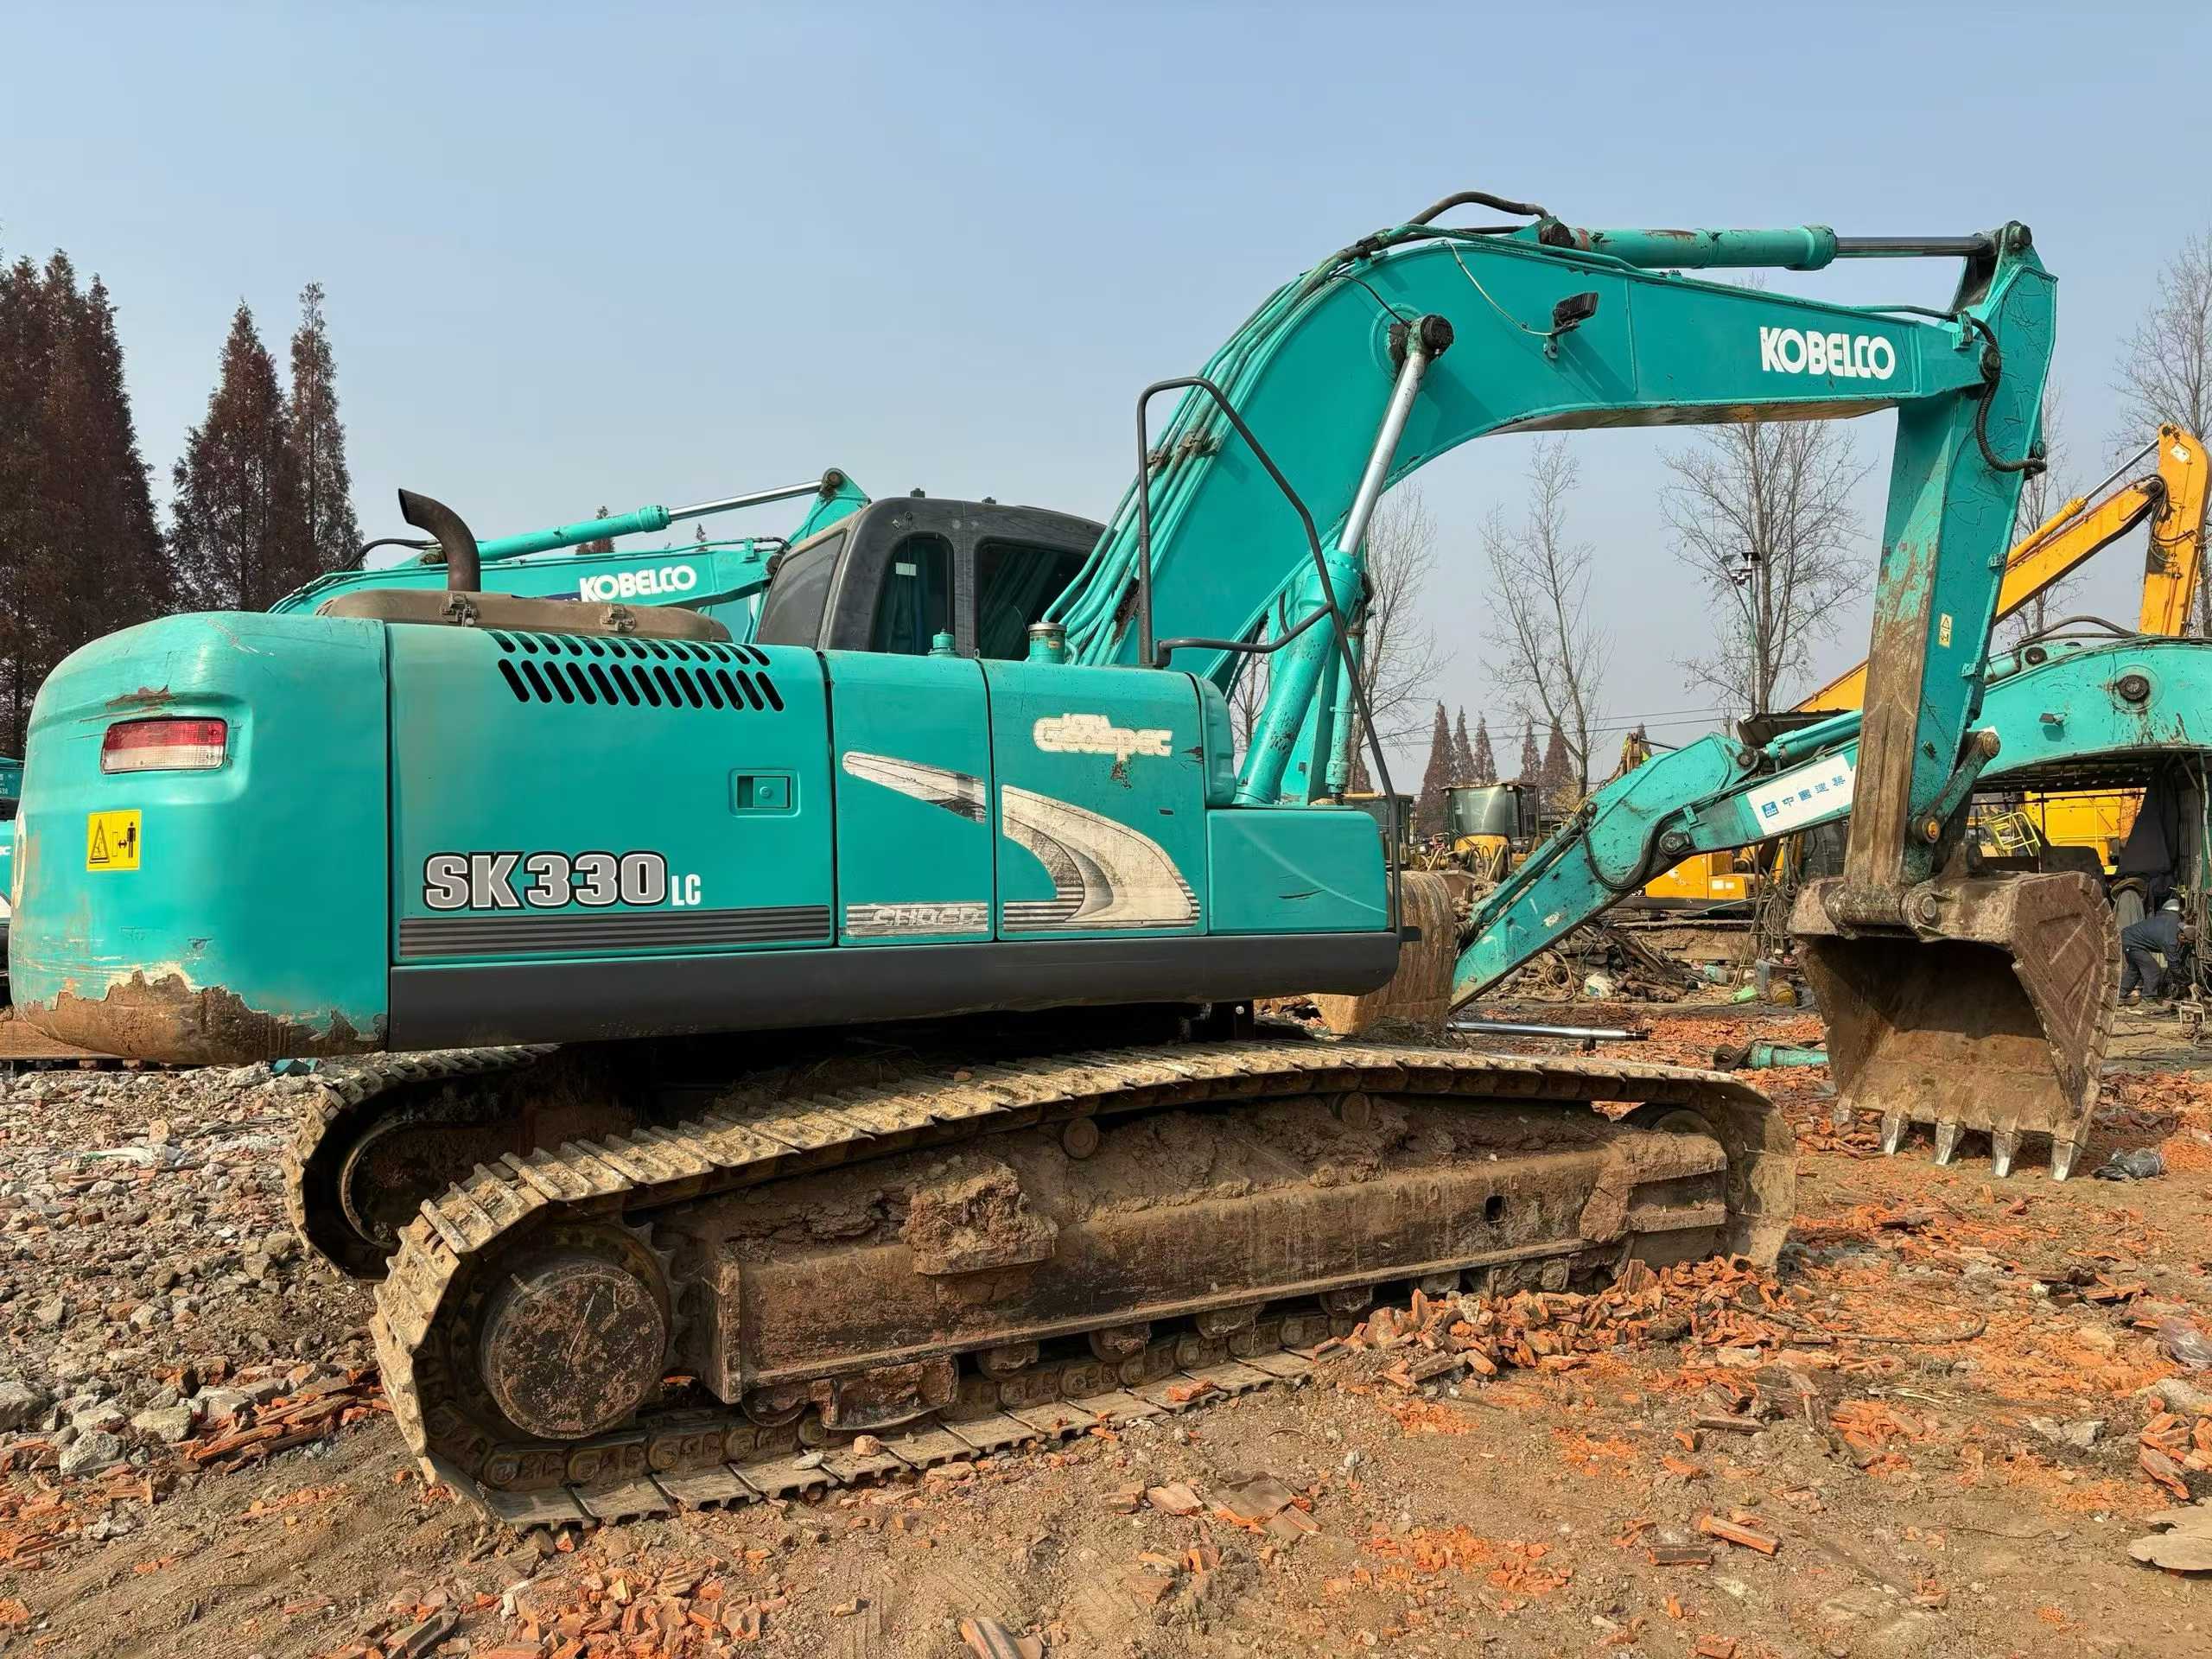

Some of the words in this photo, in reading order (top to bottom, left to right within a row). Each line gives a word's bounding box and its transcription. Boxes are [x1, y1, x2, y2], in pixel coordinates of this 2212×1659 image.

[1759, 326, 1896, 380] KOBELCO
[579, 565, 697, 602] KOBELCO
[423, 850, 669, 911] SK330
[671, 874, 702, 906] LC
